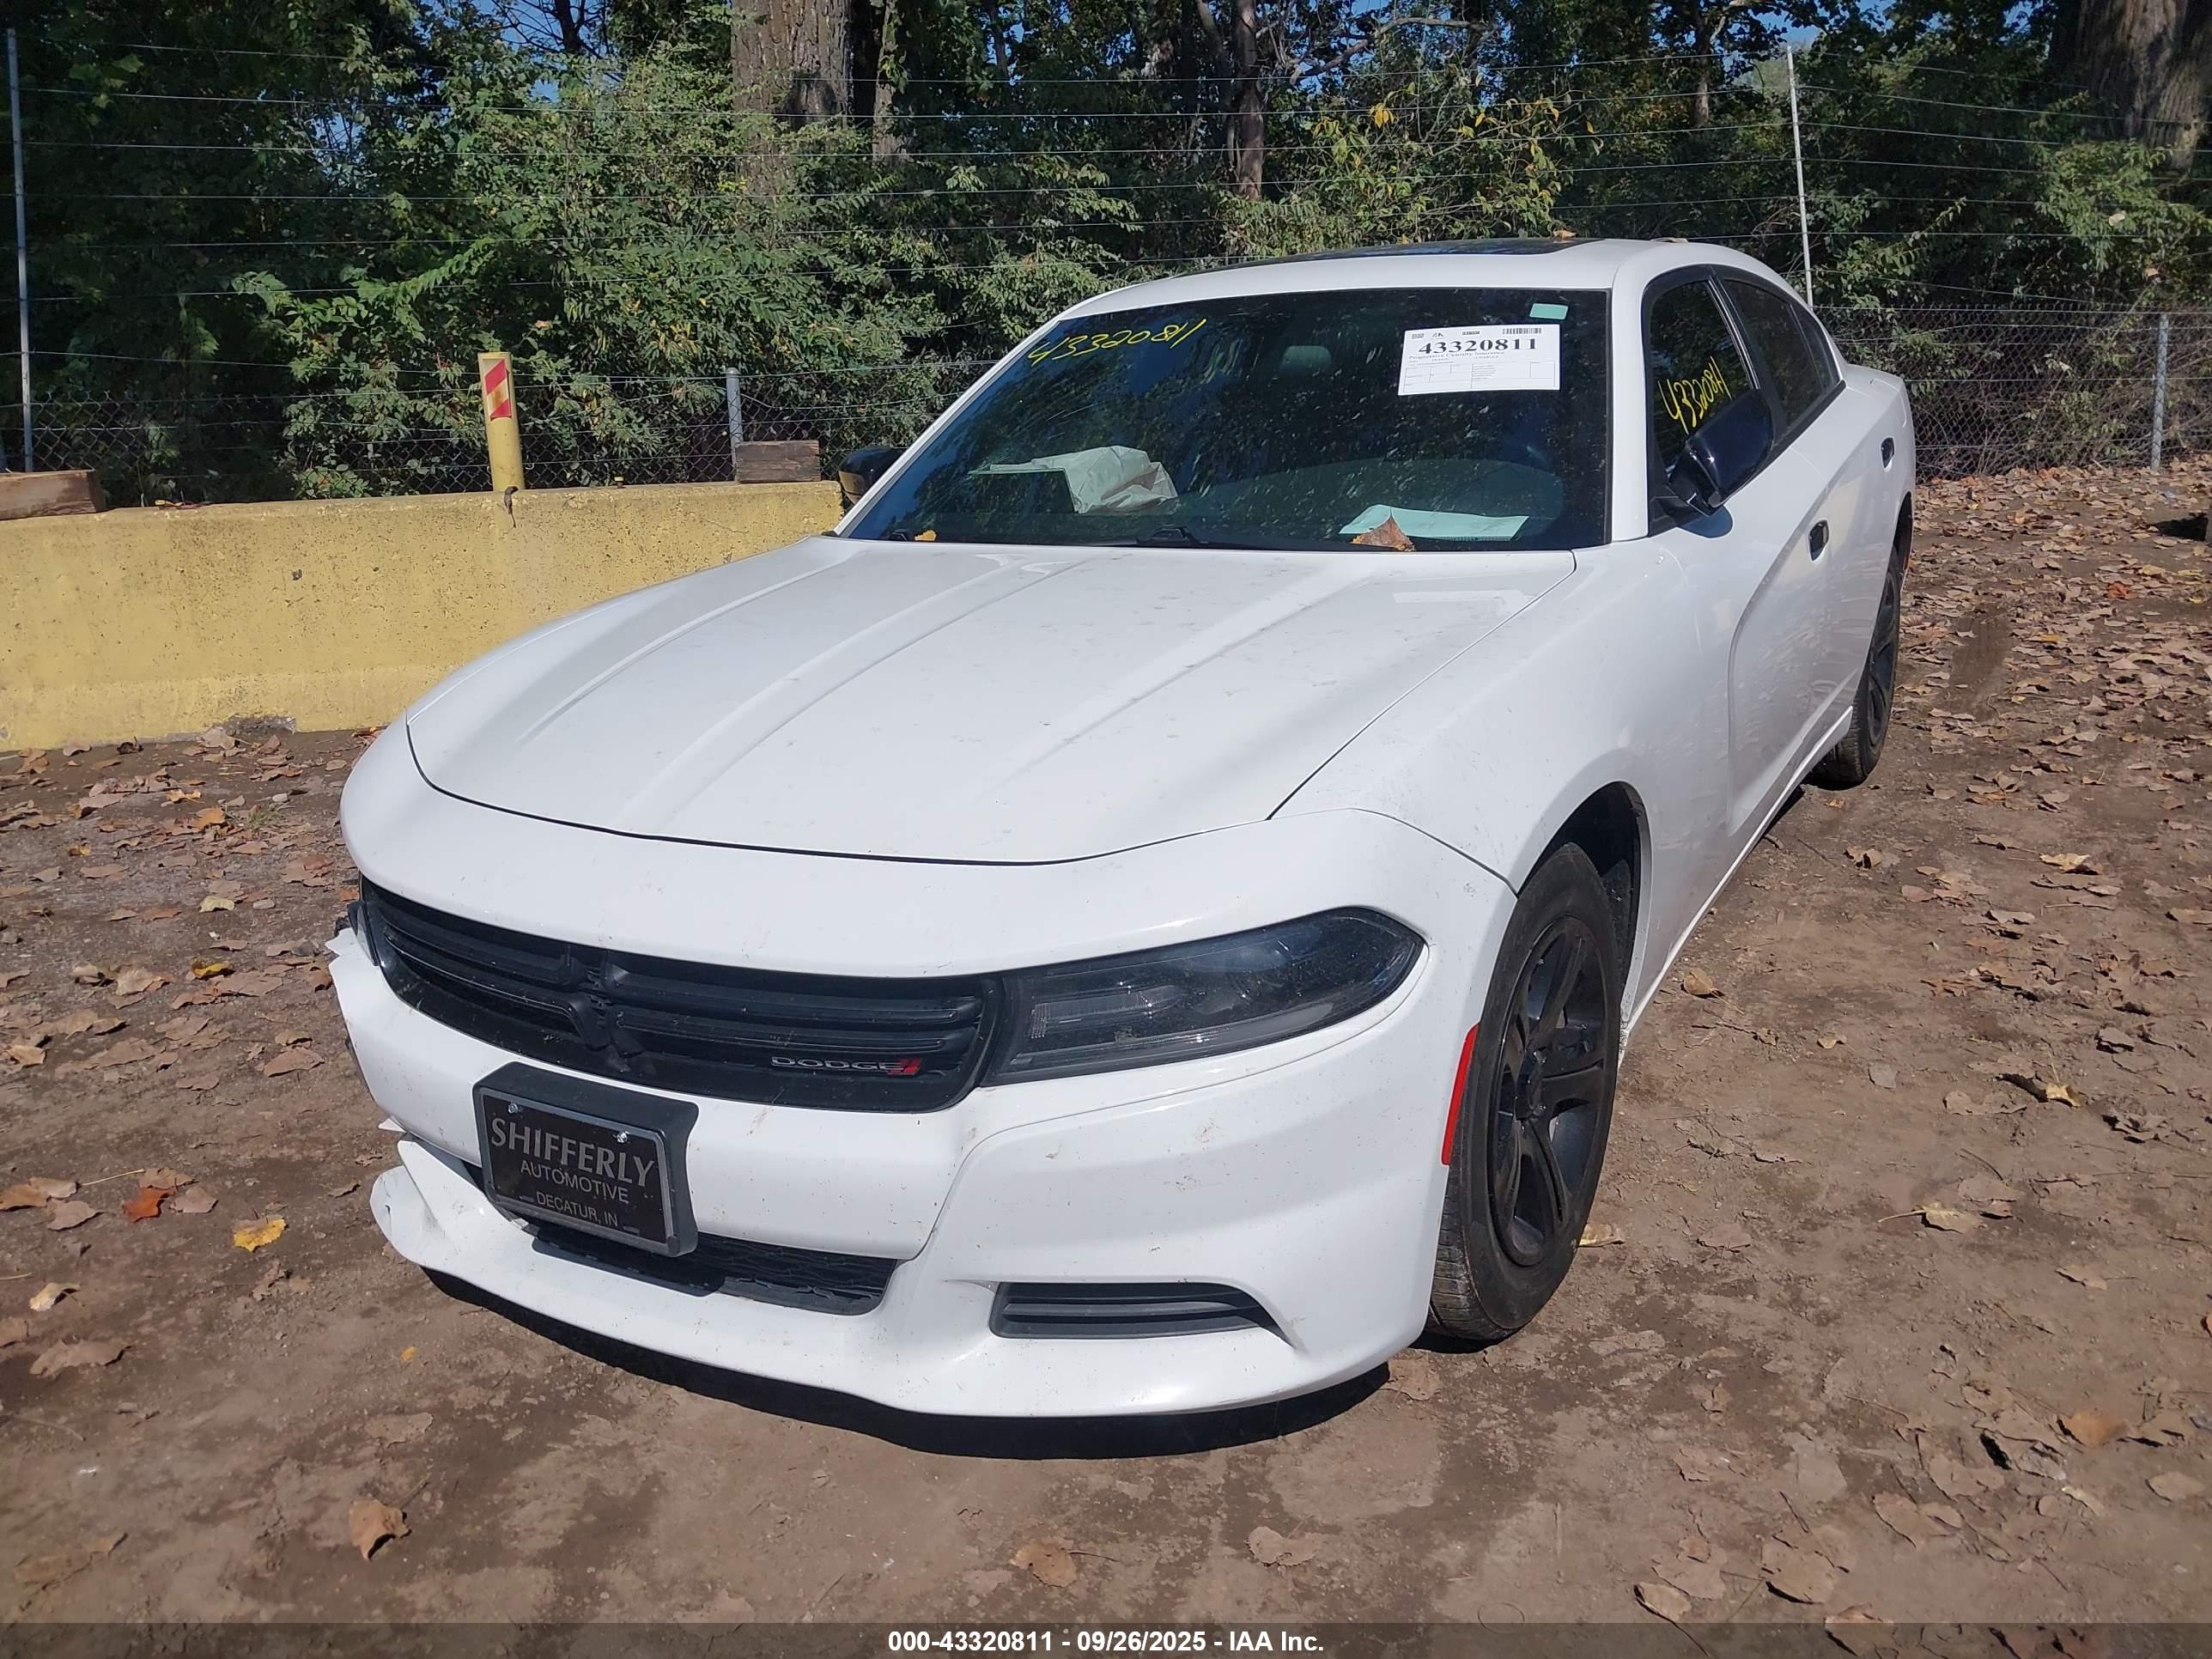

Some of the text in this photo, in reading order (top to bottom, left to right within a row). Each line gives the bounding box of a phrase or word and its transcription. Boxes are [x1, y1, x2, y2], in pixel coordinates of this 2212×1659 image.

[1027, 318, 1206, 367] 43320811
[1419, 337, 1538, 355] 43320811
[771, 1056, 904, 1072] DODGE
[491, 1117, 655, 1188] SHIFFERLY
[520, 1159, 630, 1204] AUTOMOTIVE
[536, 1191, 619, 1227] DECATUR, IN
